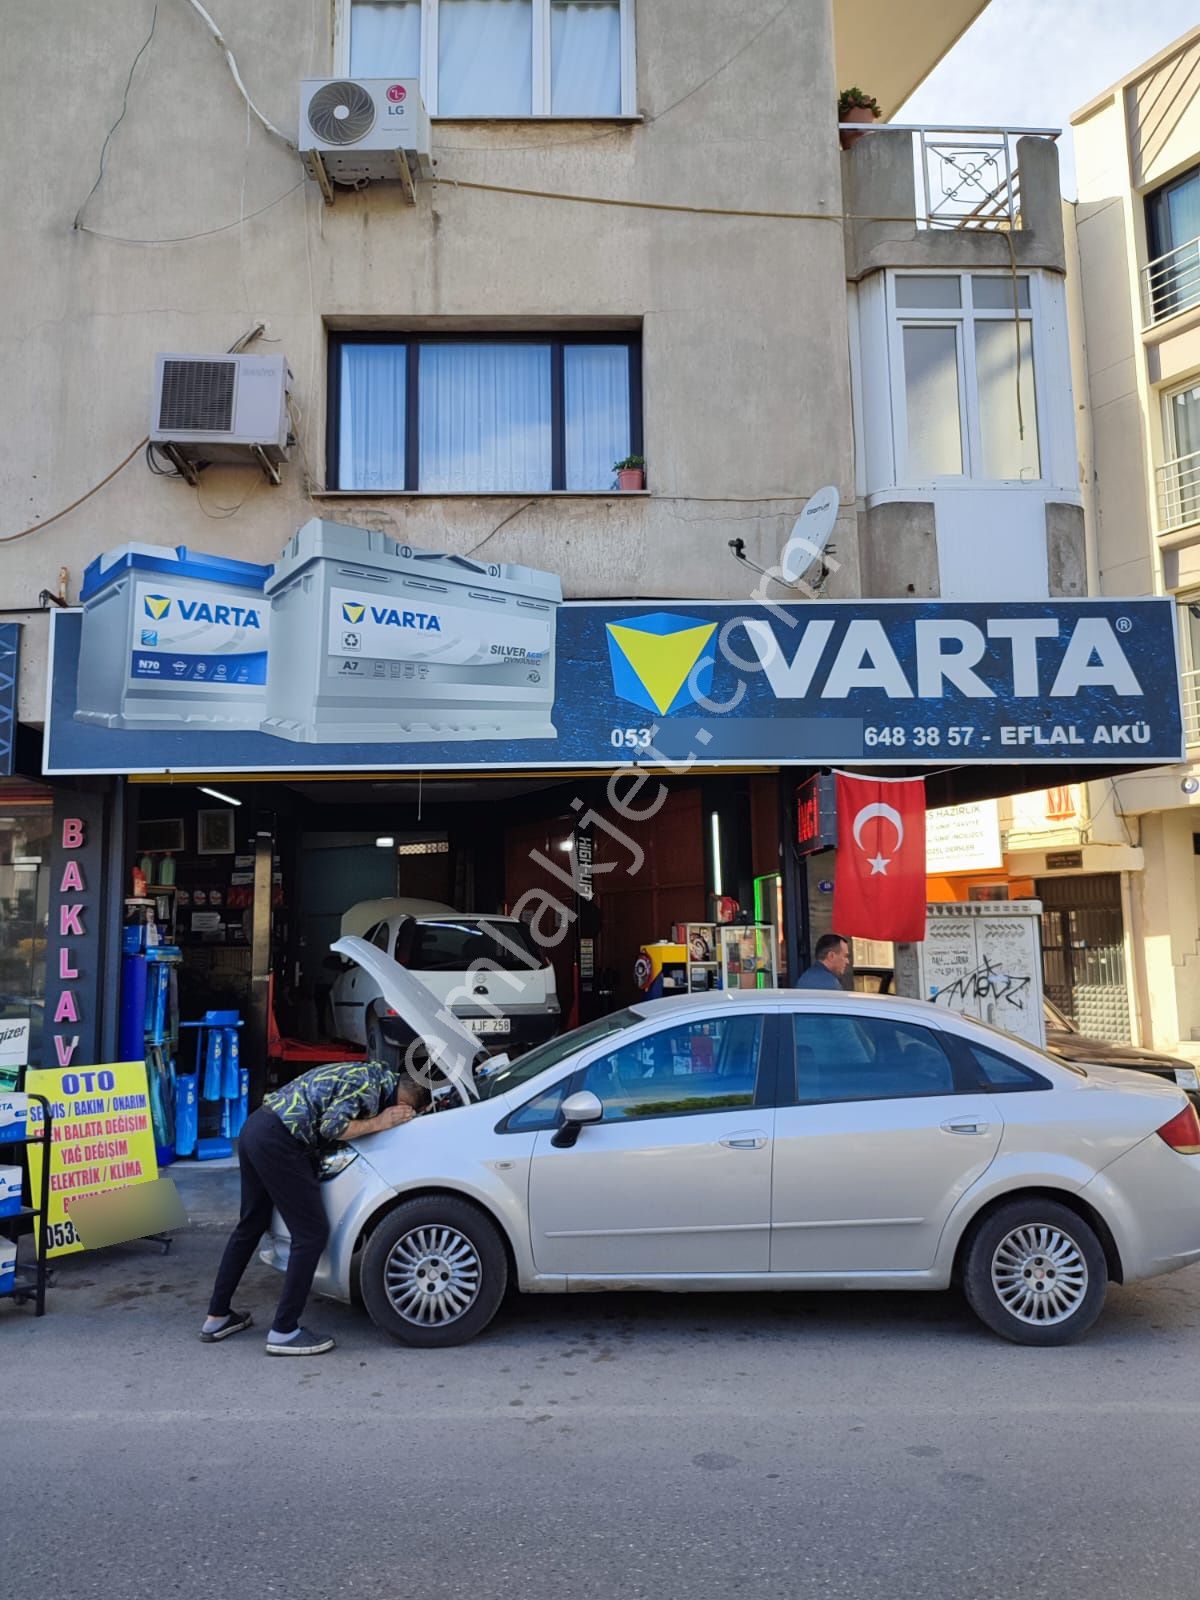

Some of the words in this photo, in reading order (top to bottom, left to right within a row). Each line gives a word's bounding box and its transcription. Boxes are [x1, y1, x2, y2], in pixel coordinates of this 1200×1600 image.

[388, 106, 404, 115] LG
[177, 599, 261, 629] VARTA
[370, 606, 441, 632] VARTA
[490, 644, 526, 657] SILVER
[742, 617, 1144, 699] VARTA
[138, 659, 160, 670] N70
[342, 661, 359, 670] A7
[864, 726, 905, 747] 648
[912, 726, 941, 747] 38
[947, 726, 974, 747] 57
[1000, 725, 1084, 746] EFLAL
[1092, 721, 1151, 745] AKÜ
[472, 1020, 488, 1031] AJF
[493, 1020, 510, 1031] 258
[61, 1070, 115, 1095] OTO
[29, 1101, 65, 1122] SEVİS
[74, 1098, 105, 1117] BAKIM
[113, 1094, 147, 1111] ONARIM
[64, 1121, 103, 1141] BALATA
[105, 1115, 148, 1136] DEĞİŞİM
[61, 1144, 82, 1165] YAĞ
[84, 1140, 128, 1161] DEĞİŞİM
[51, 1166, 100, 1191] ELEKTRİK
[109, 1160, 142, 1180] KLİMA
